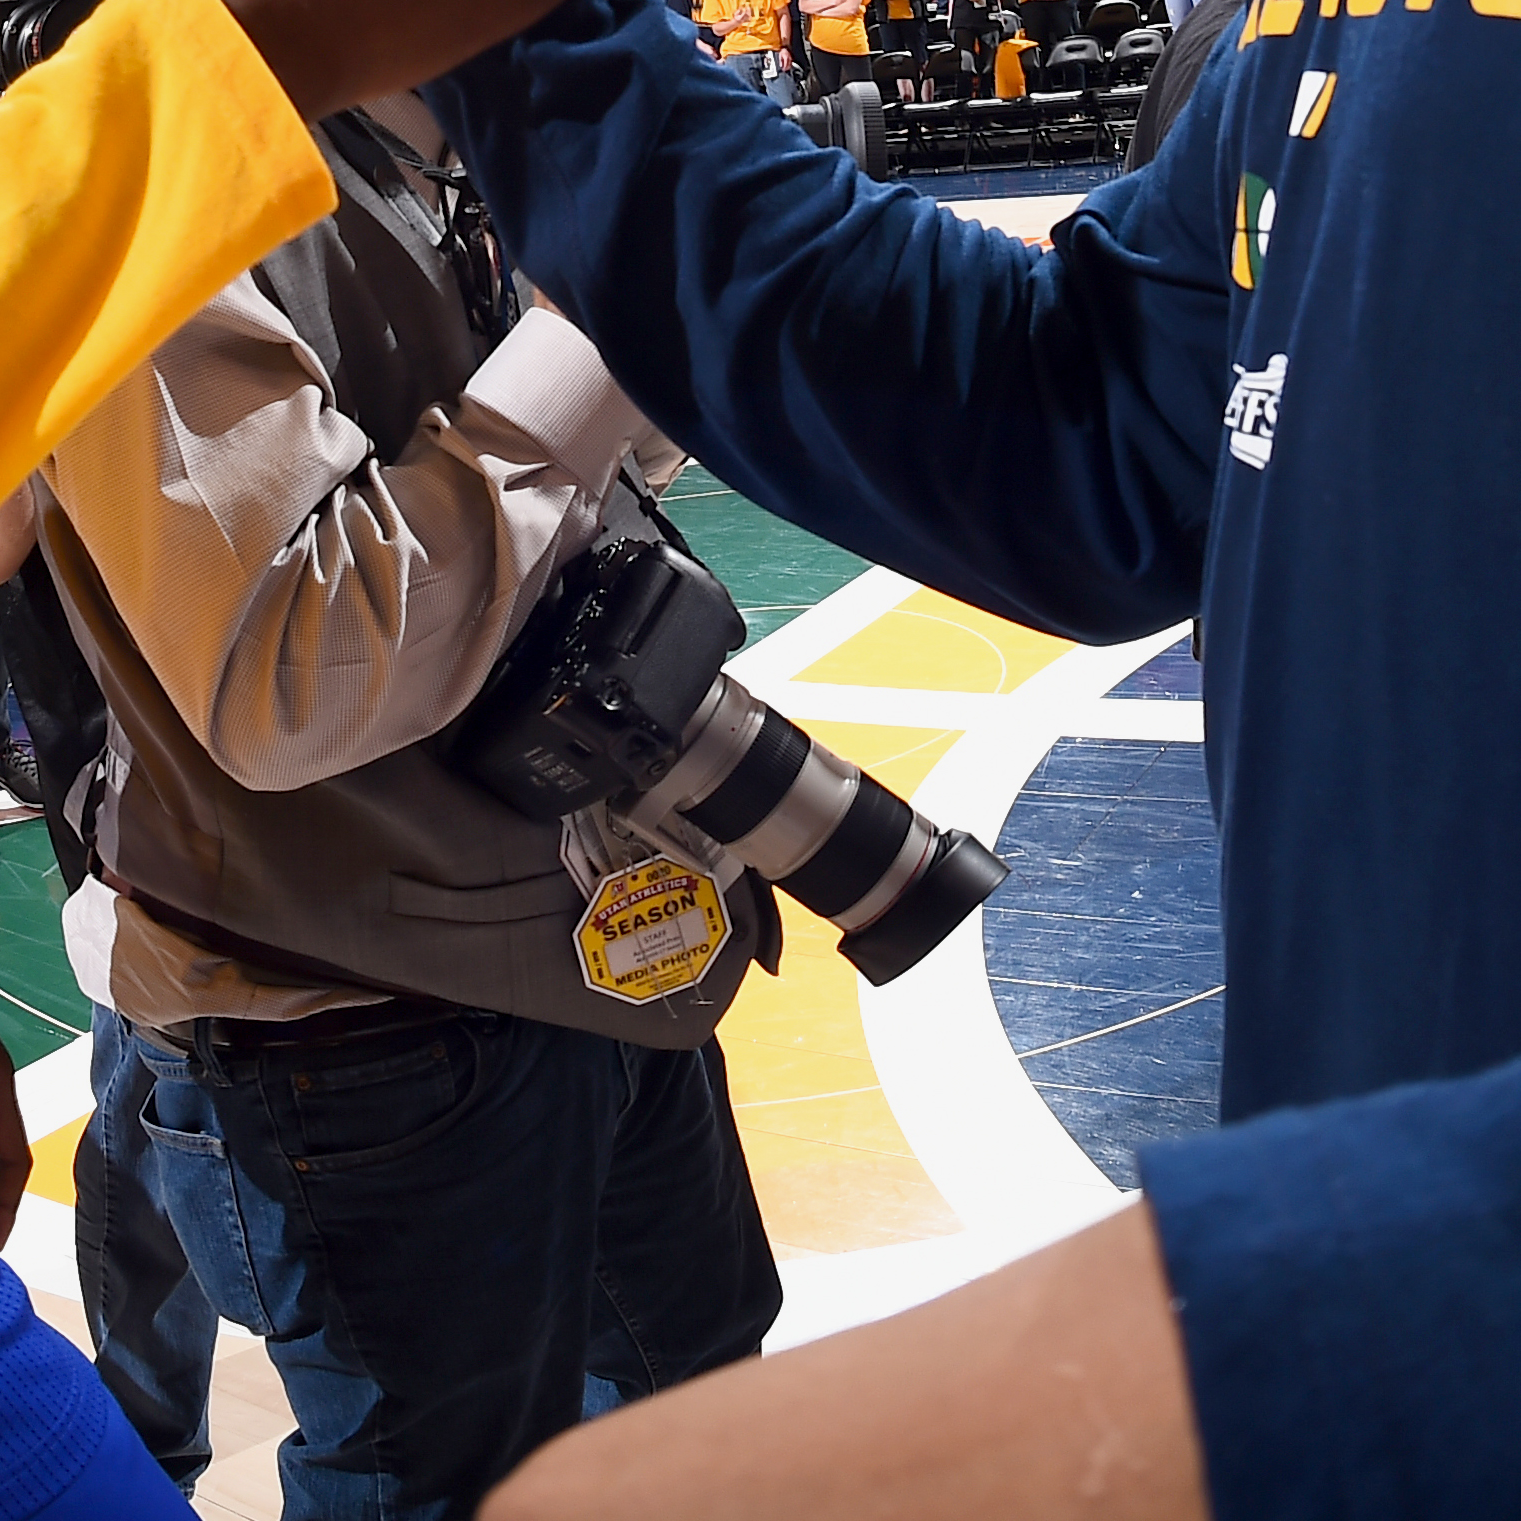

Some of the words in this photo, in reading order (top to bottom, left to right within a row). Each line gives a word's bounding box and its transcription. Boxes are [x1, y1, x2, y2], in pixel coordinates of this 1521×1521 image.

[598, 899, 628, 921] UTAH
[629, 877, 689, 903] ATHLETICS
[602, 892, 696, 942] SEASON
[643, 930, 667, 944] STAFF
[615, 964, 660, 987] MEDIA
[661, 943, 710, 970] PHOTO
